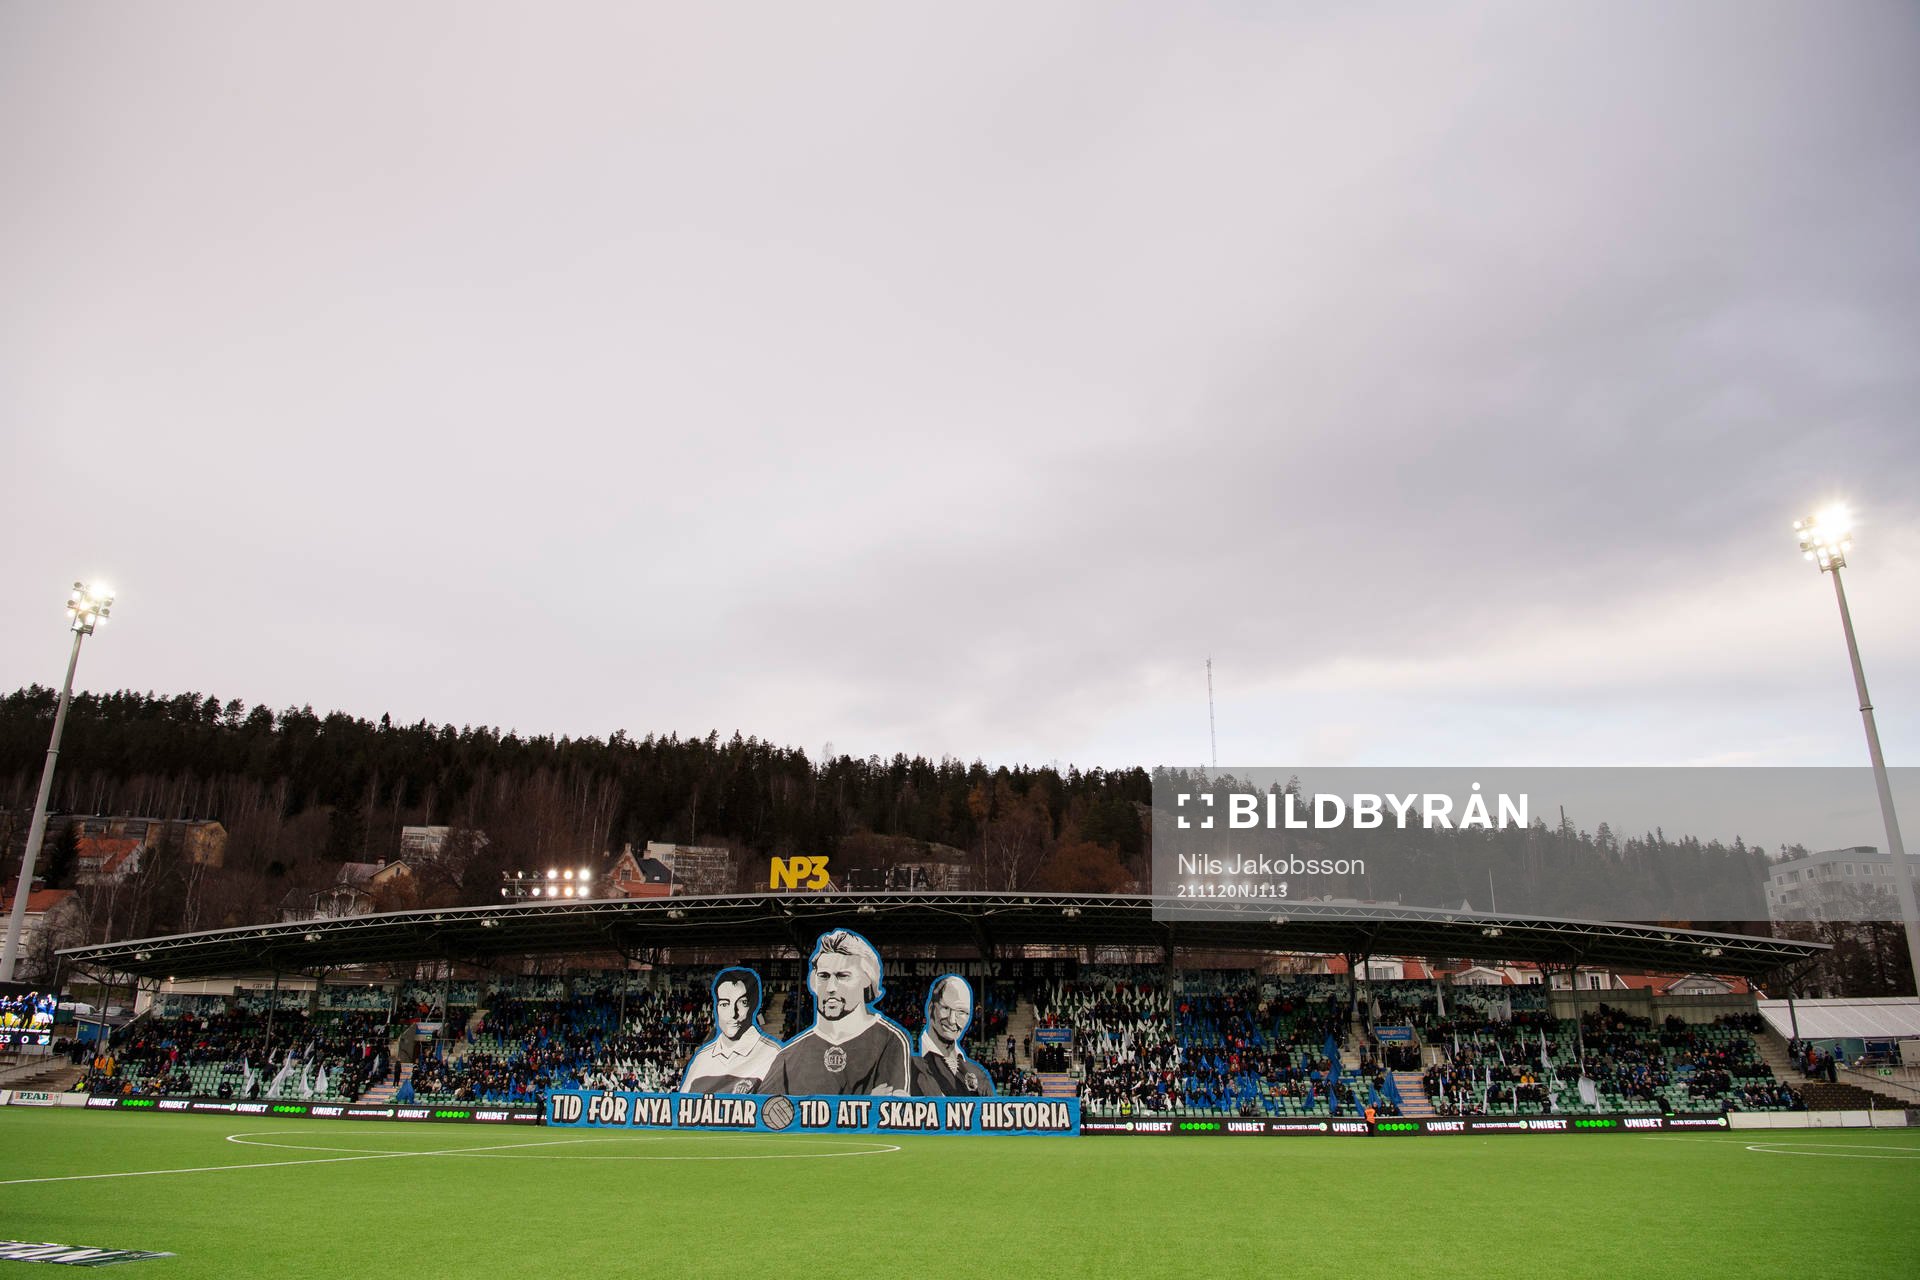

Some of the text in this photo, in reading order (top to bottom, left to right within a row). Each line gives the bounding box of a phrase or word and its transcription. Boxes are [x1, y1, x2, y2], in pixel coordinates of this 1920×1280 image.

[770, 856, 829, 889] NP3
[20, 1092, 49, 1100] PEAB
[88, 1098, 118, 1107] UNIBET
[158, 1100, 189, 1109] UNIBET
[237, 1104, 268, 1113] UNIBET
[312, 1106, 344, 1116] UNIBET
[553, 1092, 1070, 1130] TID FÖR NYA HJÄLTAR TID ATT SKAPA NY HISTORIA
[397, 1109, 430, 1118] UNIBET
[476, 1111, 509, 1120] UNIBET
[1135, 1122, 1172, 1131] UNIBET
[1228, 1122, 1265, 1132] UNIBET
[1426, 1121, 1464, 1131] UNIBET
[1529, 1120, 1567, 1129] UNIBET
[1624, 1118, 1662, 1128] UNIBET
